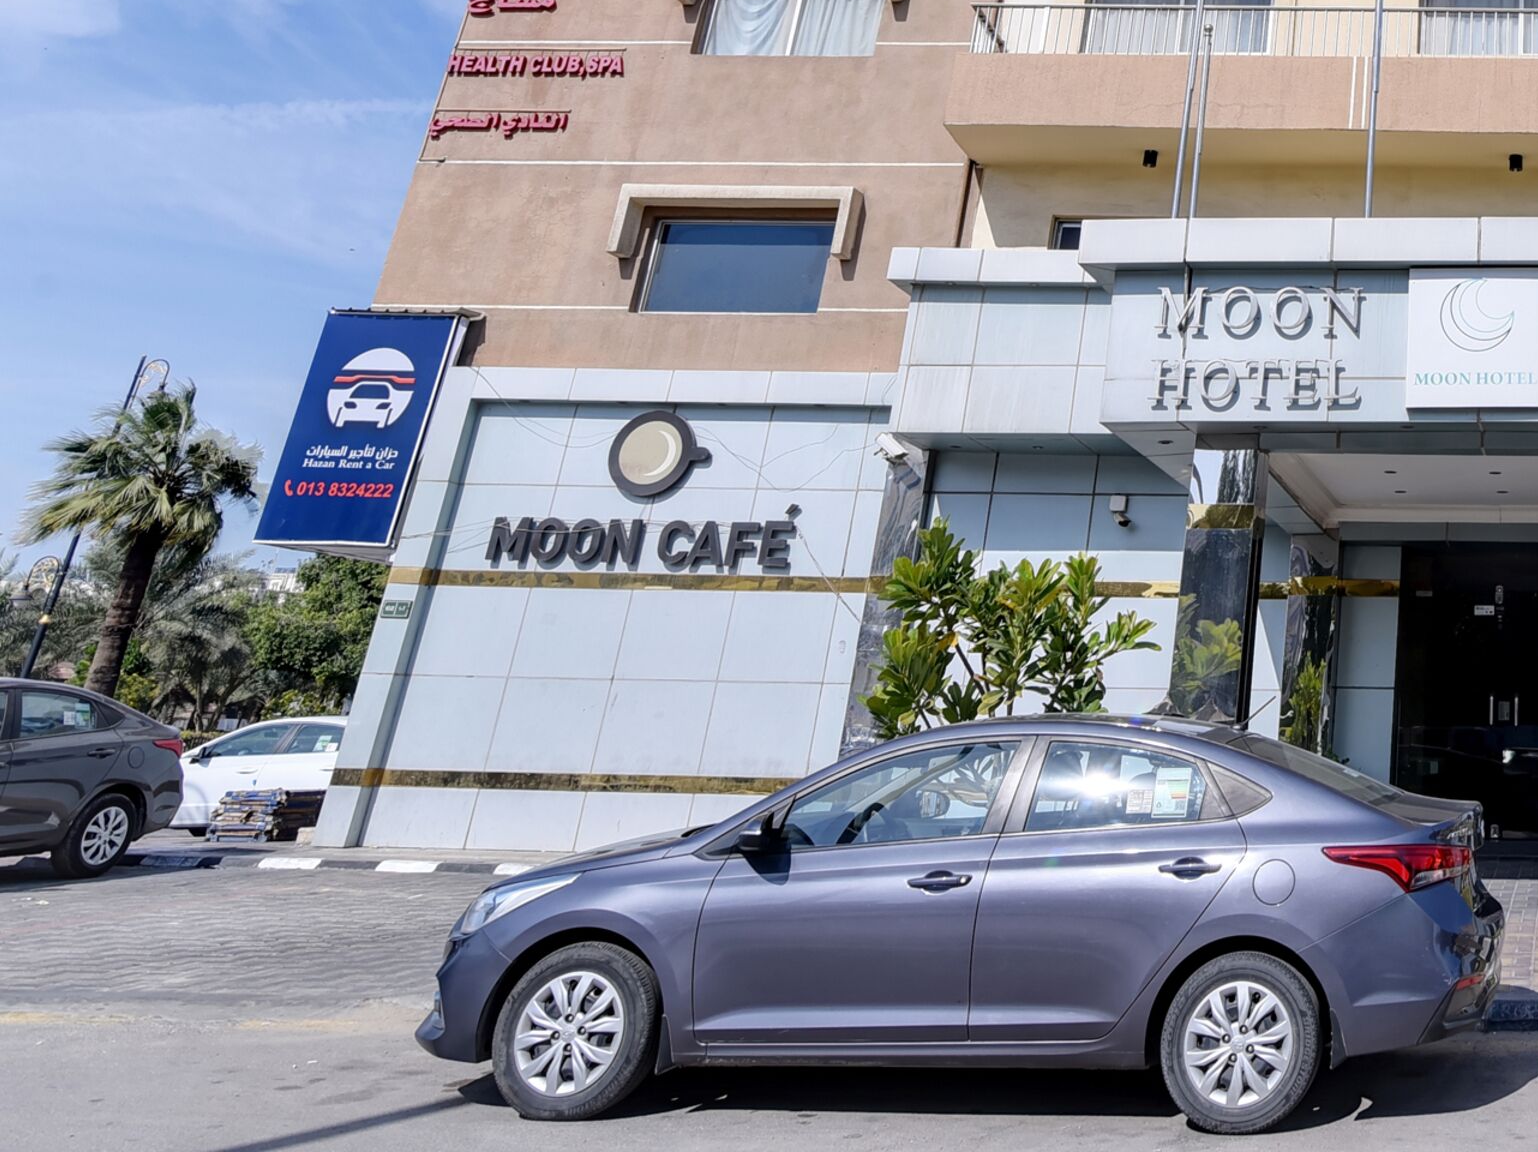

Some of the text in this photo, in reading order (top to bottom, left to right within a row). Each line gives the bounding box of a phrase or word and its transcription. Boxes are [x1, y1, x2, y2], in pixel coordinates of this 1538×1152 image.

[447, 54, 528, 77] HEALTH
[1154, 286, 1366, 338] MOON
[1147, 358, 1362, 408] HOTEL
[1414, 371, 1538, 385] MOON HOTEL
[302, 458, 396, 470] Hazan Rent a Car
[296, 480, 395, 498] 013 8324222
[485, 503, 802, 568] MOON CAFÉ
